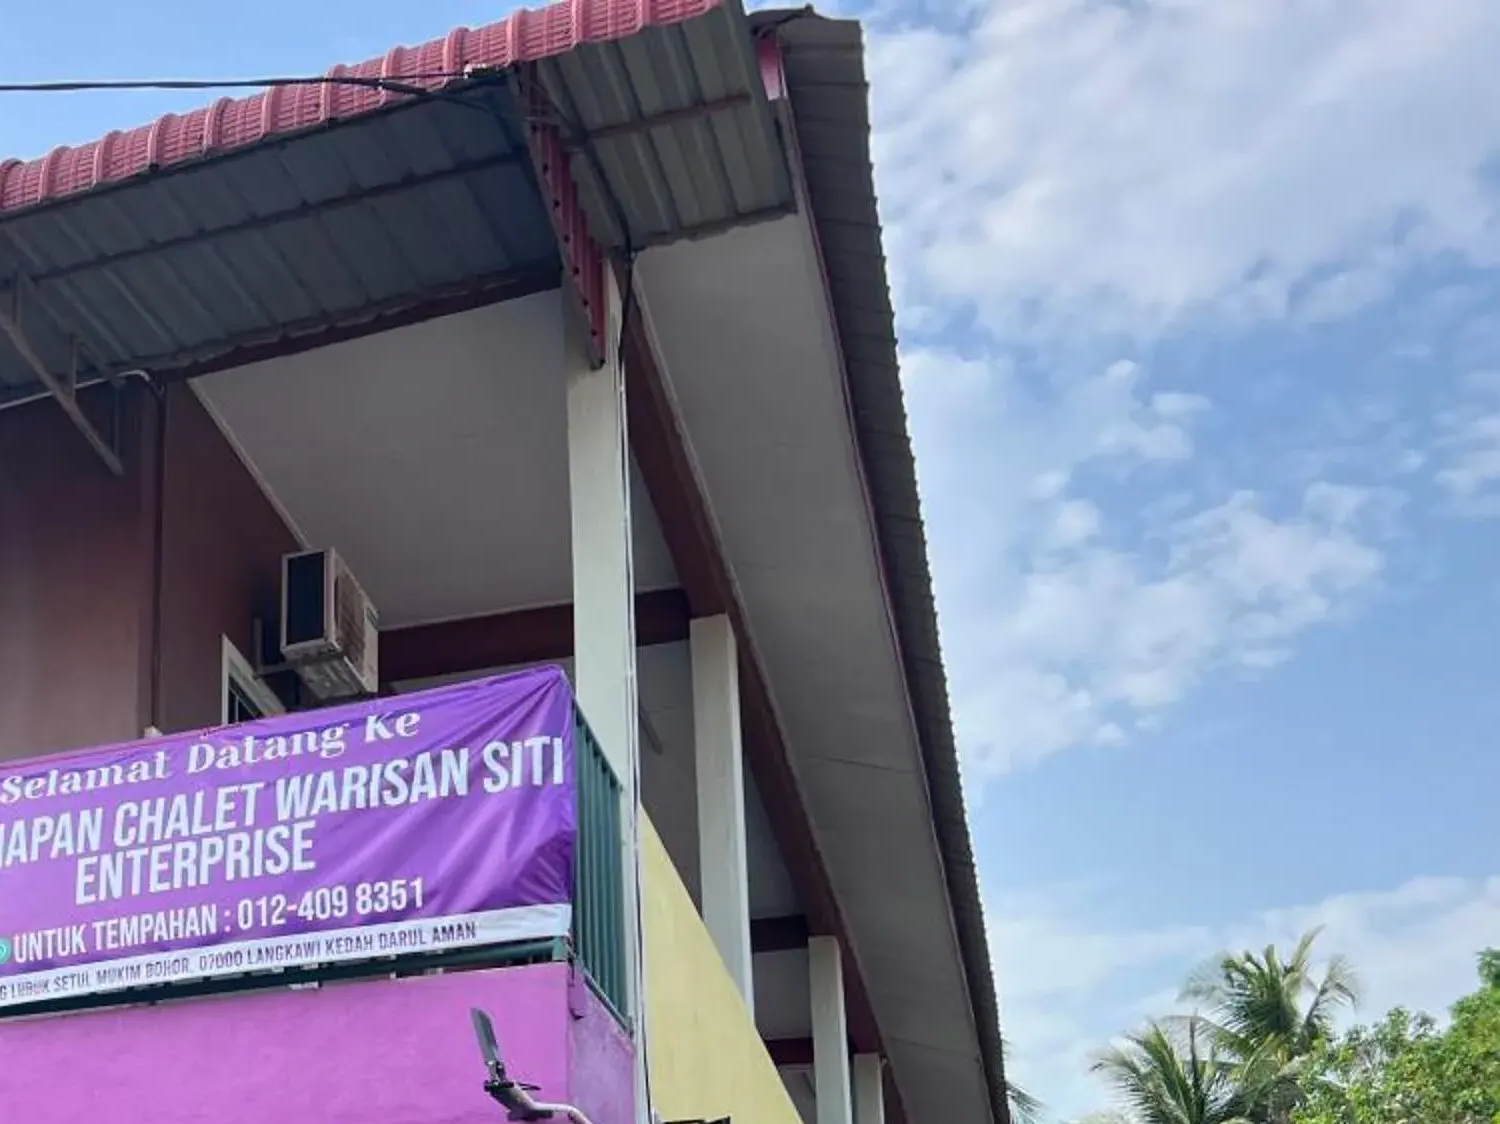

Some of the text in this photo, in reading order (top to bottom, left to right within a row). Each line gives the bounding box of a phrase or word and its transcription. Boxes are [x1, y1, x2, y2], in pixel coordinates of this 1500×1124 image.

[0, 711, 421, 804] Selamat Datang Ke
[113, 781, 265, 847] CHALET
[276, 747, 469, 821] WARISAN
[483, 736, 564, 792] SITI
[76, 820, 316, 905] ENTERPRISE
[13, 924, 87, 963] UNTUK
[92, 903, 217, 950] TEMPAHAN
[237, 885, 348, 930] 012-409
[355, 876, 424, 915] 8351
[54, 971, 91, 992] SETUL
[96, 964, 141, 985] MUKIM
[199, 949, 244, 972] 07000
[248, 940, 320, 964] LANGKAWI
[325, 933, 373, 955] KEDAH
[379, 927, 427, 948] DARUL
[432, 921, 477, 944] AMAN
